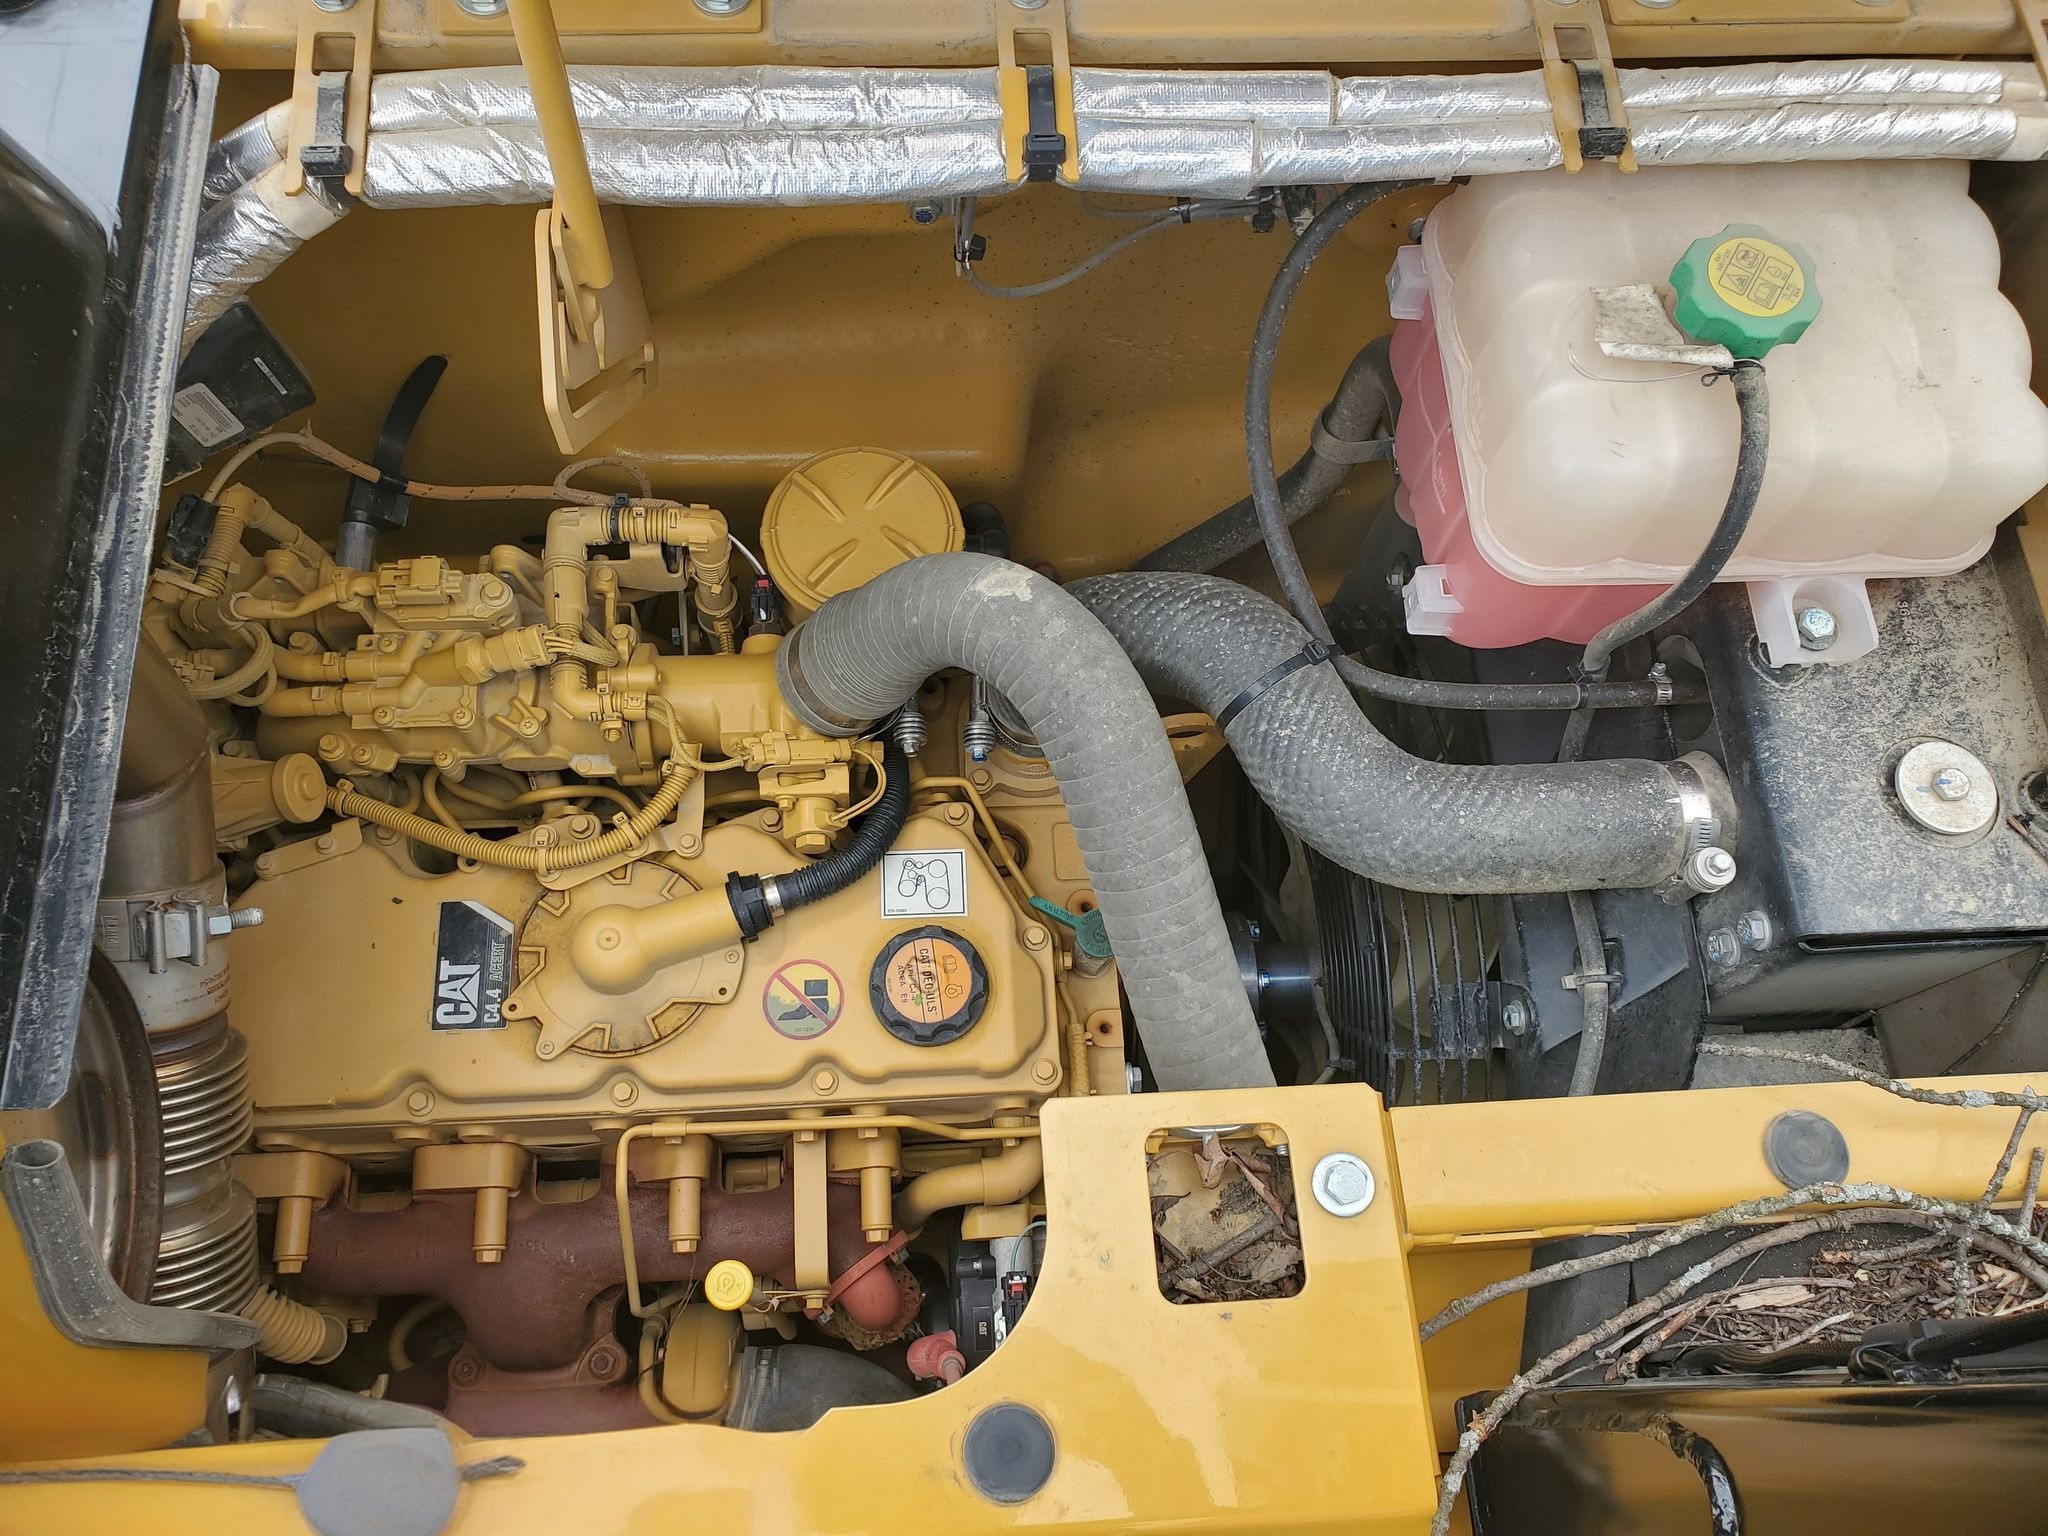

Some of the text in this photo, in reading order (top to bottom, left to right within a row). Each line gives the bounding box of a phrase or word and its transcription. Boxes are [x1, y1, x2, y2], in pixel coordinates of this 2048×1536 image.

[436, 960, 480, 1024] CAT
[484, 940, 505, 1022] C4.4 ACERT
[897, 965, 908, 1003] ACEA E9
[906, 964, 914, 977] API
[919, 948, 936, 1012] CAT DEO-ULS
[979, 1321, 988, 1336] CAT
